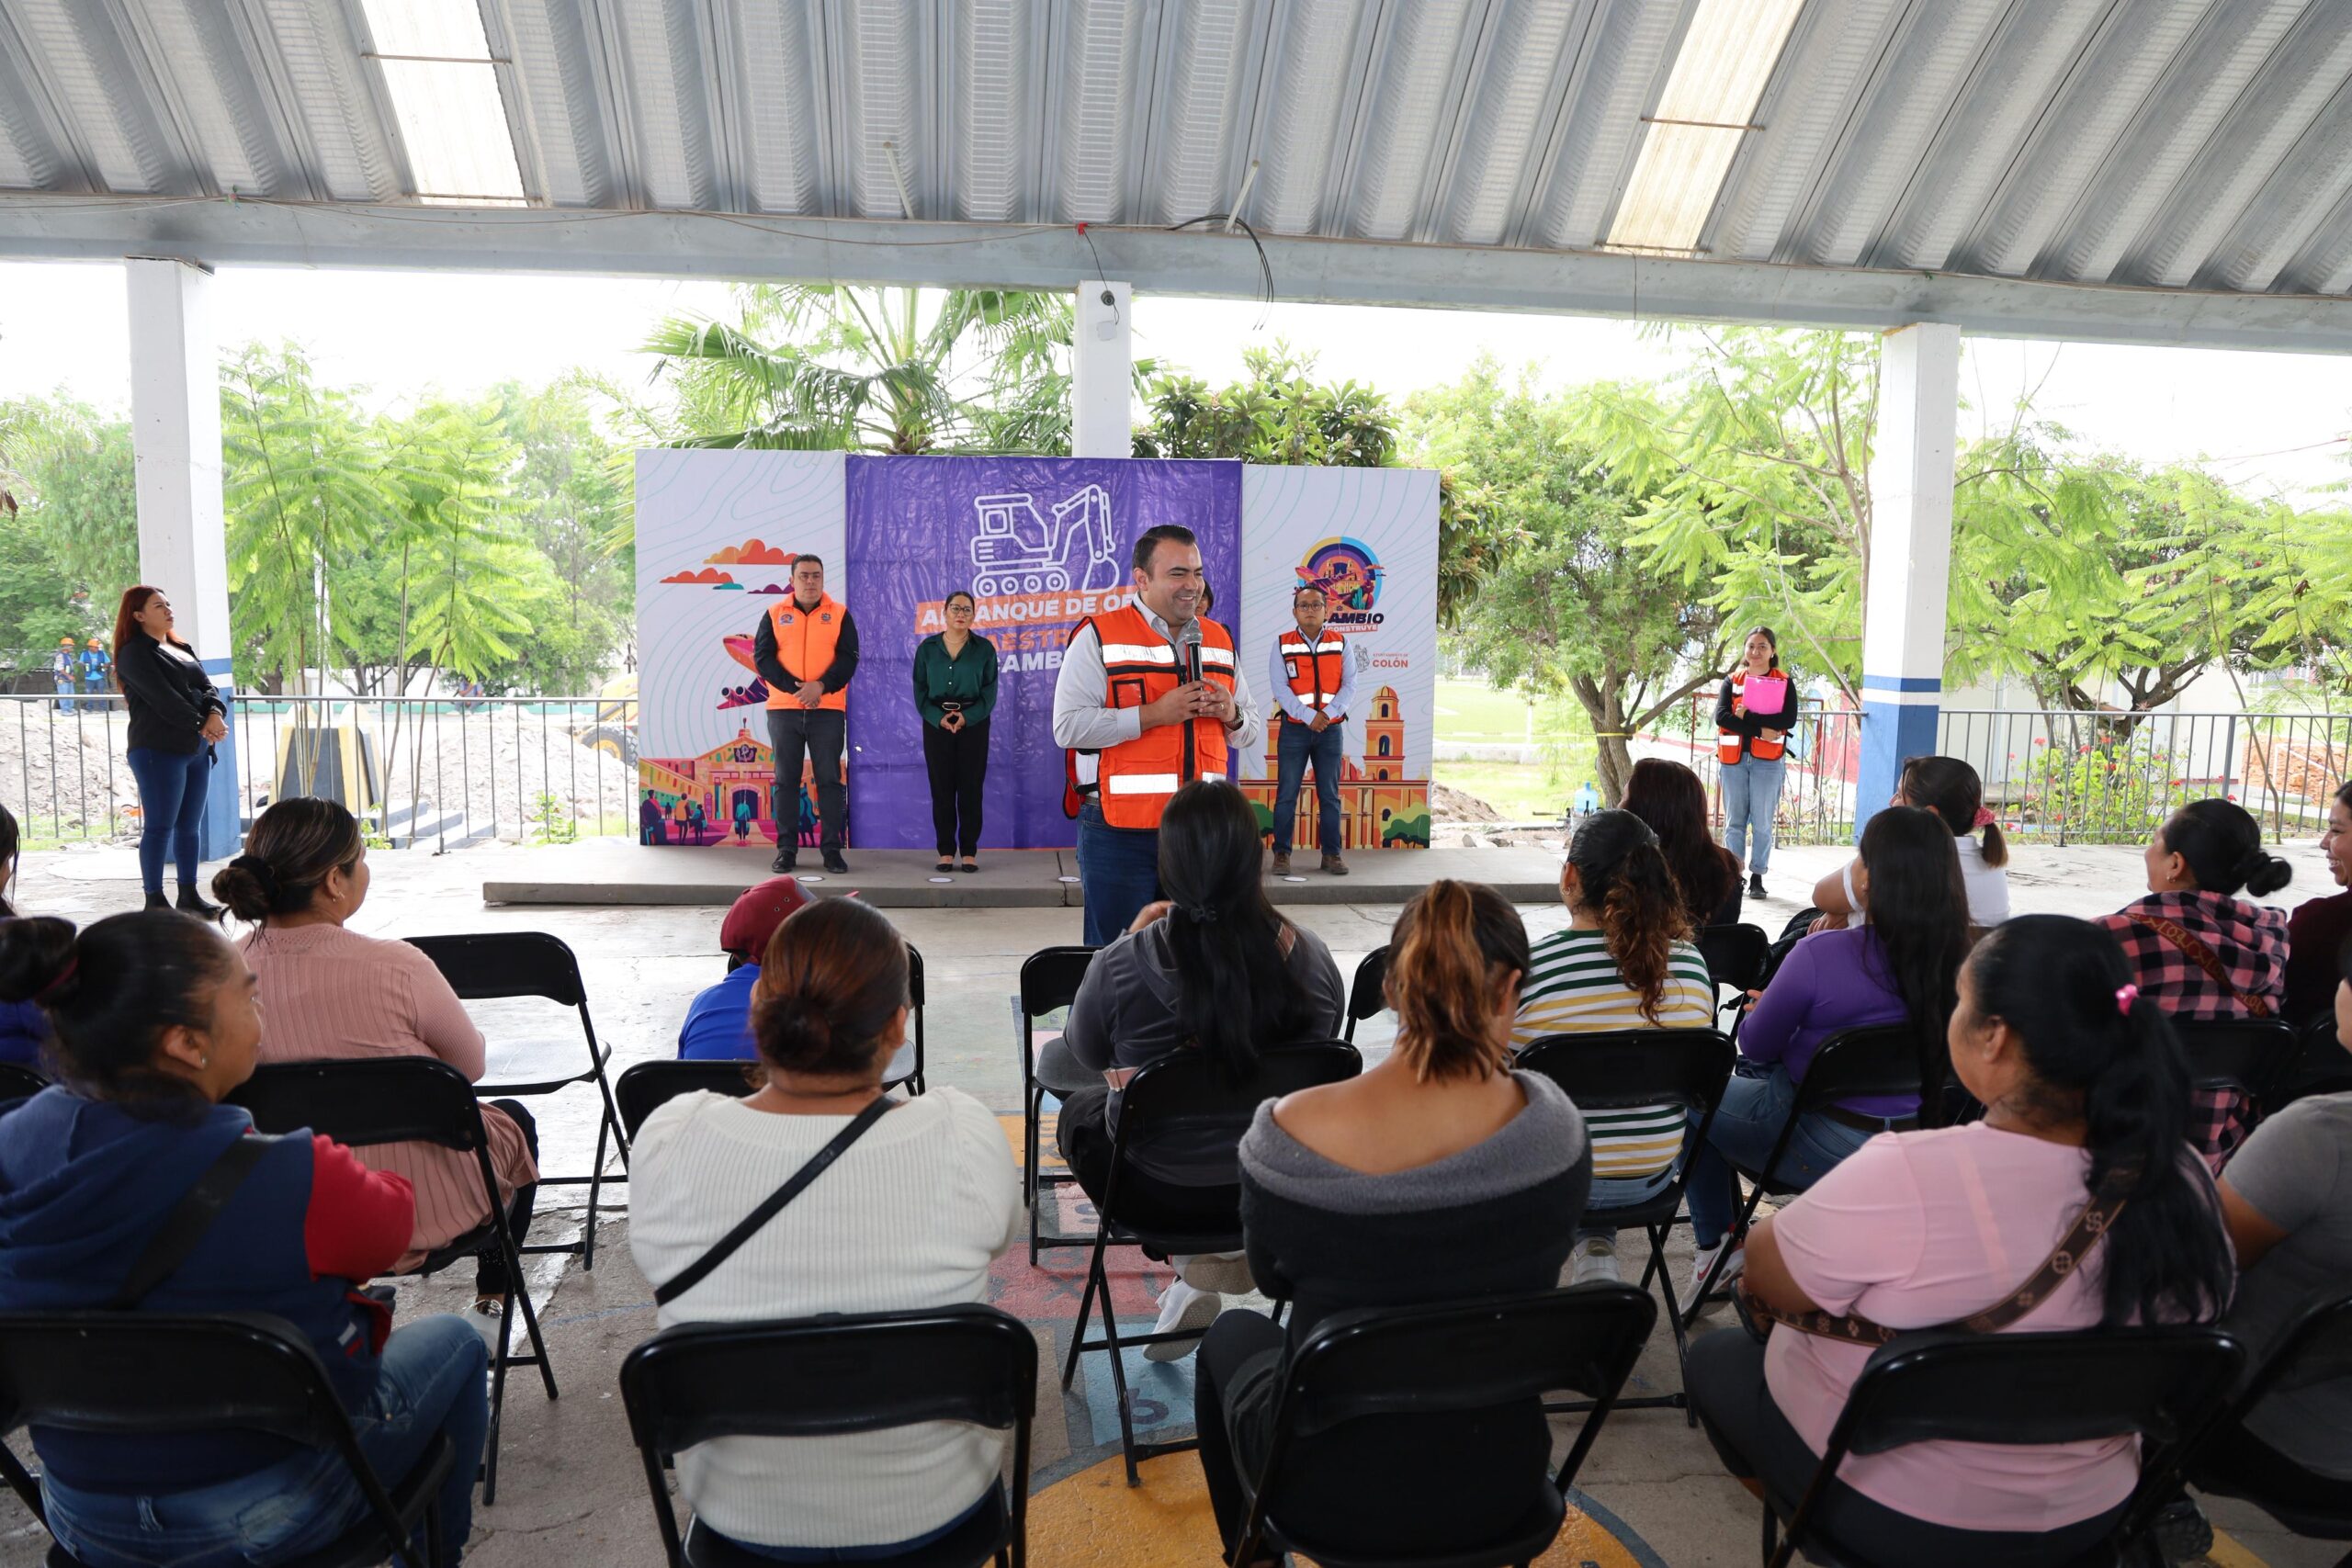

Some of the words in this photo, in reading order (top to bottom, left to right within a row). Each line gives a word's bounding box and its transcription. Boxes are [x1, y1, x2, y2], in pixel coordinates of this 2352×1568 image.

[921, 600, 1059, 626] AANQUE
[1066, 596, 1097, 615] DE
[1325, 613, 1385, 625] AMBIO
[998, 651, 1063, 672] AMB
[1373, 657, 1408, 668] COLÓN
